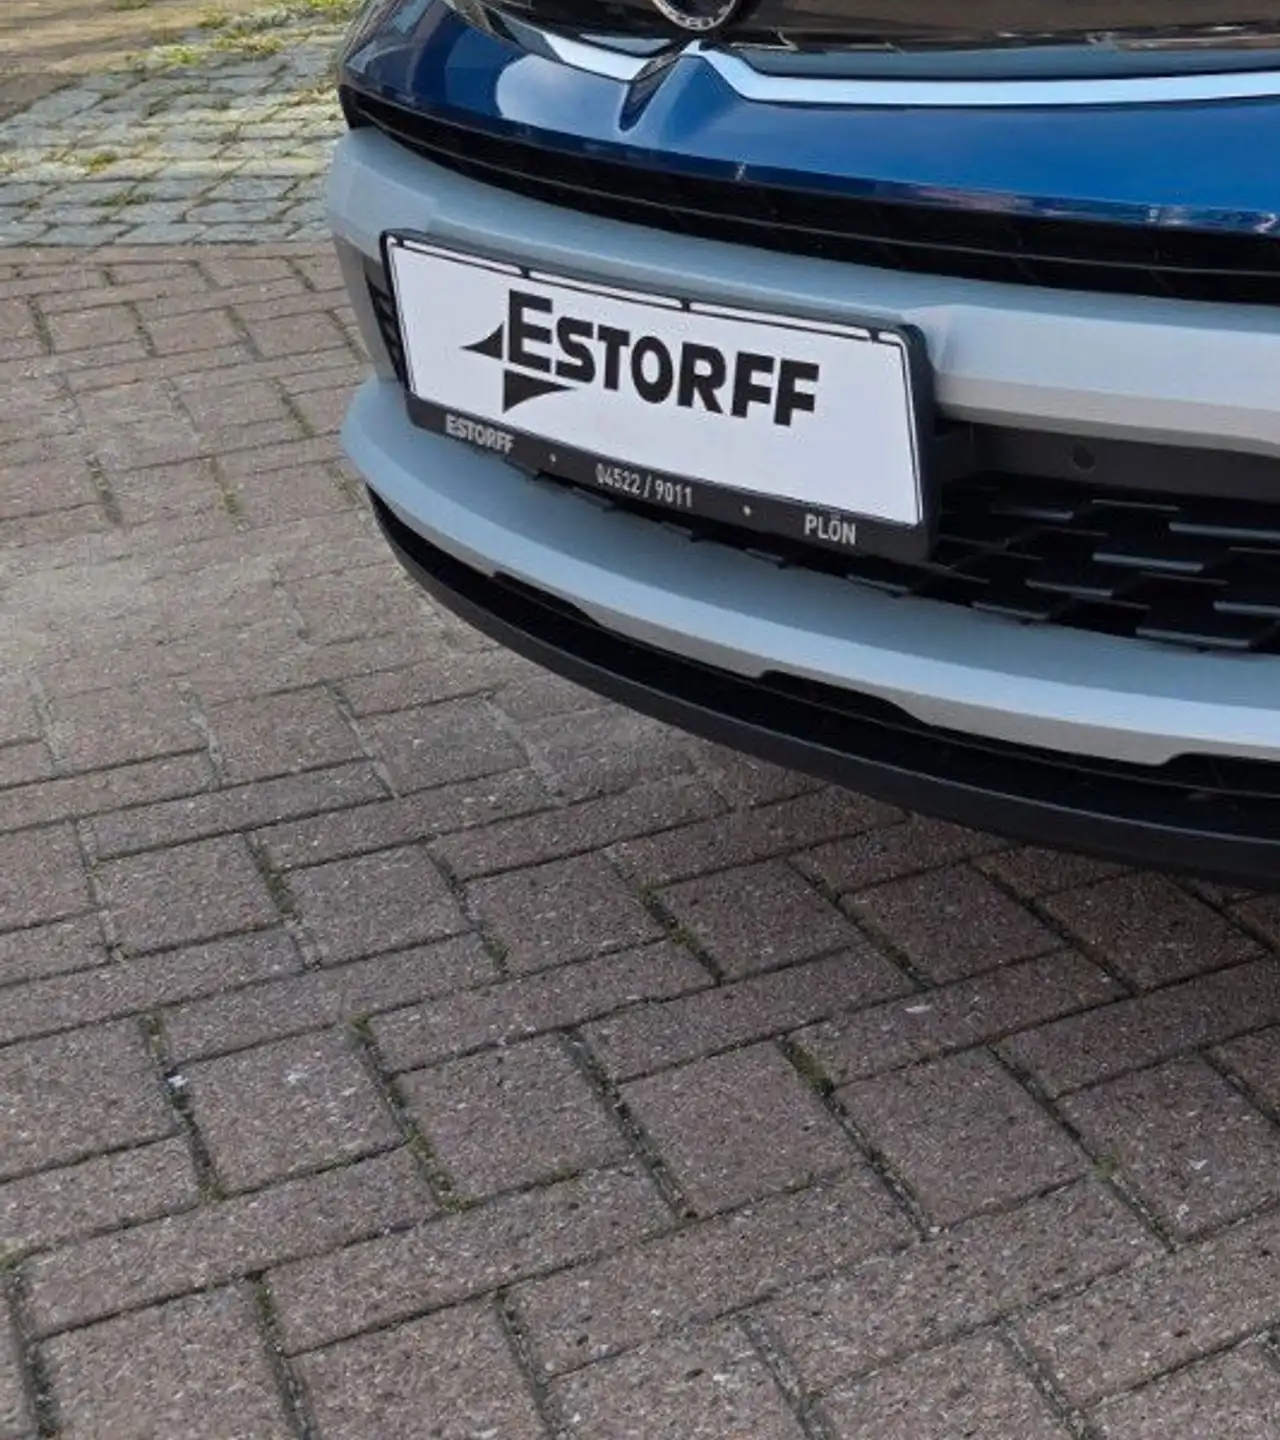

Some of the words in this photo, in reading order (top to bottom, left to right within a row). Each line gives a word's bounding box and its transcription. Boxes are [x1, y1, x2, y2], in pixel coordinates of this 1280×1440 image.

[508, 288, 820, 428] ESTORFF
[445, 413, 515, 455] ESTORFF
[595, 462, 641, 496] 04522
[655, 479, 694, 508] 9011
[804, 512, 857, 546] PLÖN
